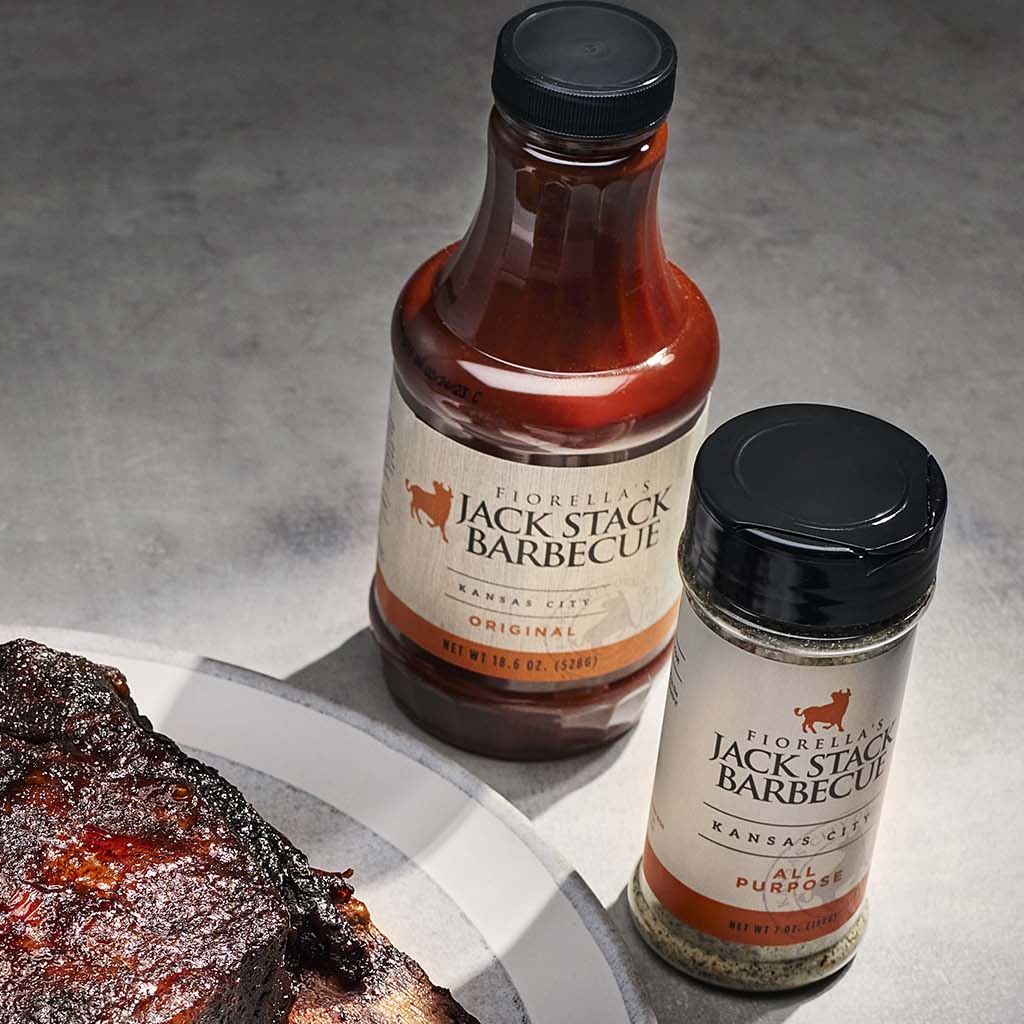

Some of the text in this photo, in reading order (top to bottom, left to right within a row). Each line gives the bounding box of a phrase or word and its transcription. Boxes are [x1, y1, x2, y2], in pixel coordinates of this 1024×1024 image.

[495, 479, 651, 507] FIORELLA'S
[455, 486, 673, 539] JACK STACK
[464, 519, 661, 568] BARBECUE
[458, 583, 590, 609] KANSAS CITY
[469, 615, 576, 637] ORIGINAL
[442, 639, 464, 653] NET
[469, 649, 486, 665] WT
[709, 719, 896, 778] JACK STACK
[747, 719, 884, 751] FIORELLA'S
[715, 751, 887, 805] BARBECUE
[712, 812, 870, 847] KANSAS CITY
[736, 869, 843, 894] PURPOSE
[773, 866, 816, 880] ALL
